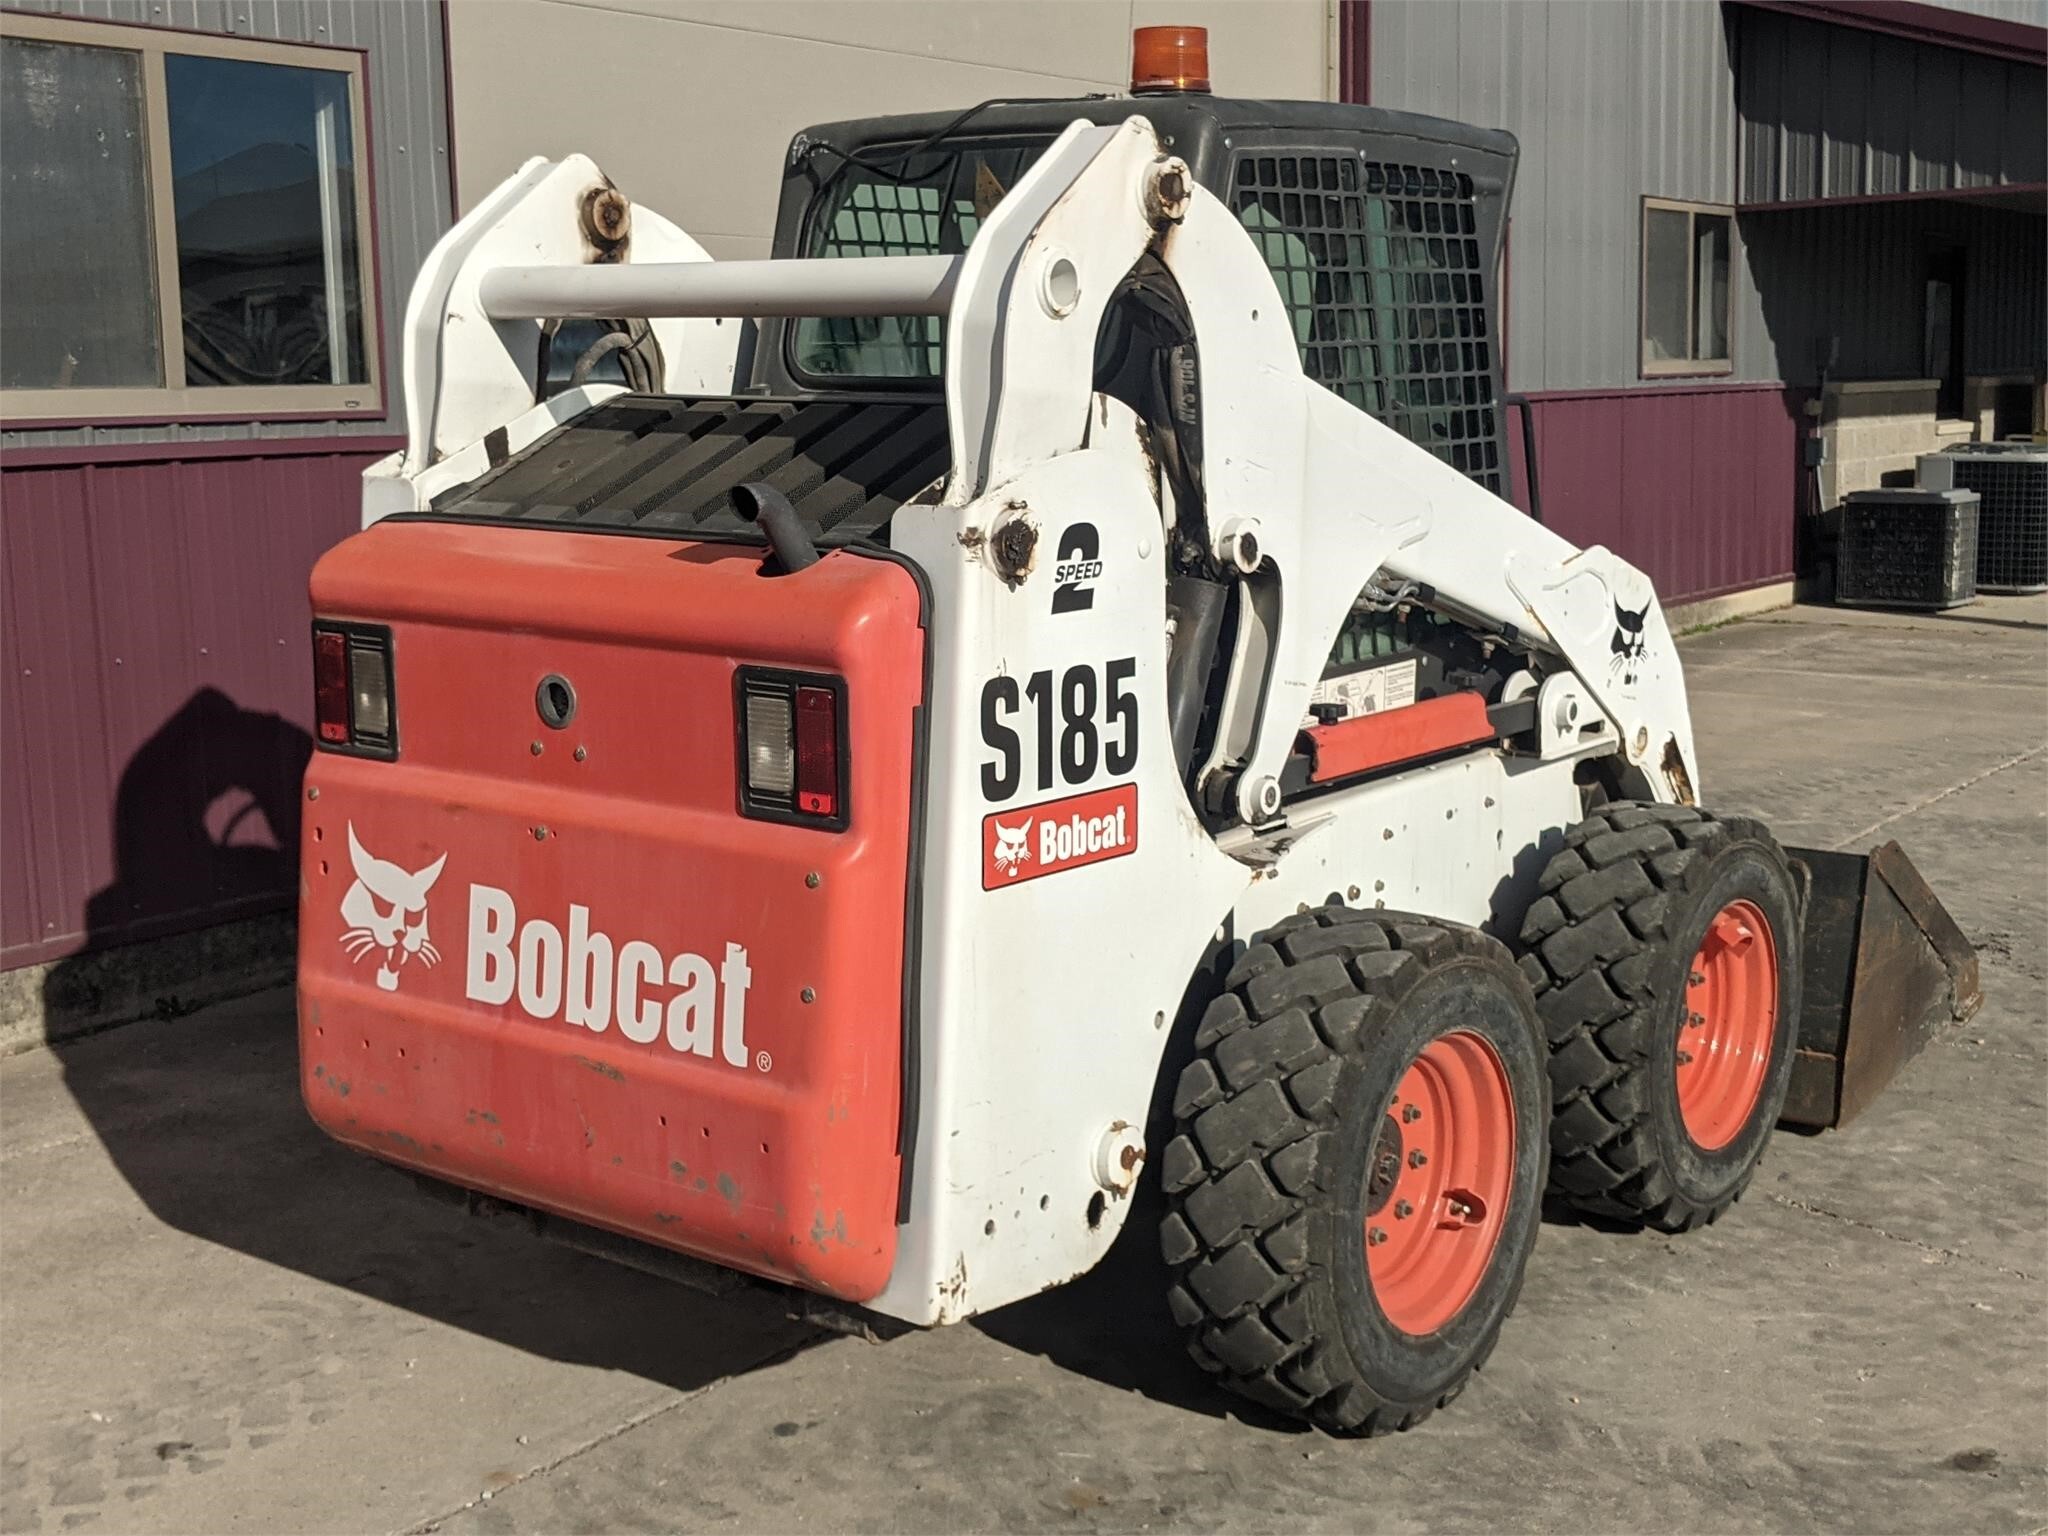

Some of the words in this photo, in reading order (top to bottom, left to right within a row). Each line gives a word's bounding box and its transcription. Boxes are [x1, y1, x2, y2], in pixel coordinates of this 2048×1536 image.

[1051, 522, 1099, 615] 2
[1054, 561, 1102, 584] SPEED
[980, 656, 1139, 802] S185
[1039, 805, 1126, 865] Bobcat
[466, 883, 752, 1068] Bobcat
